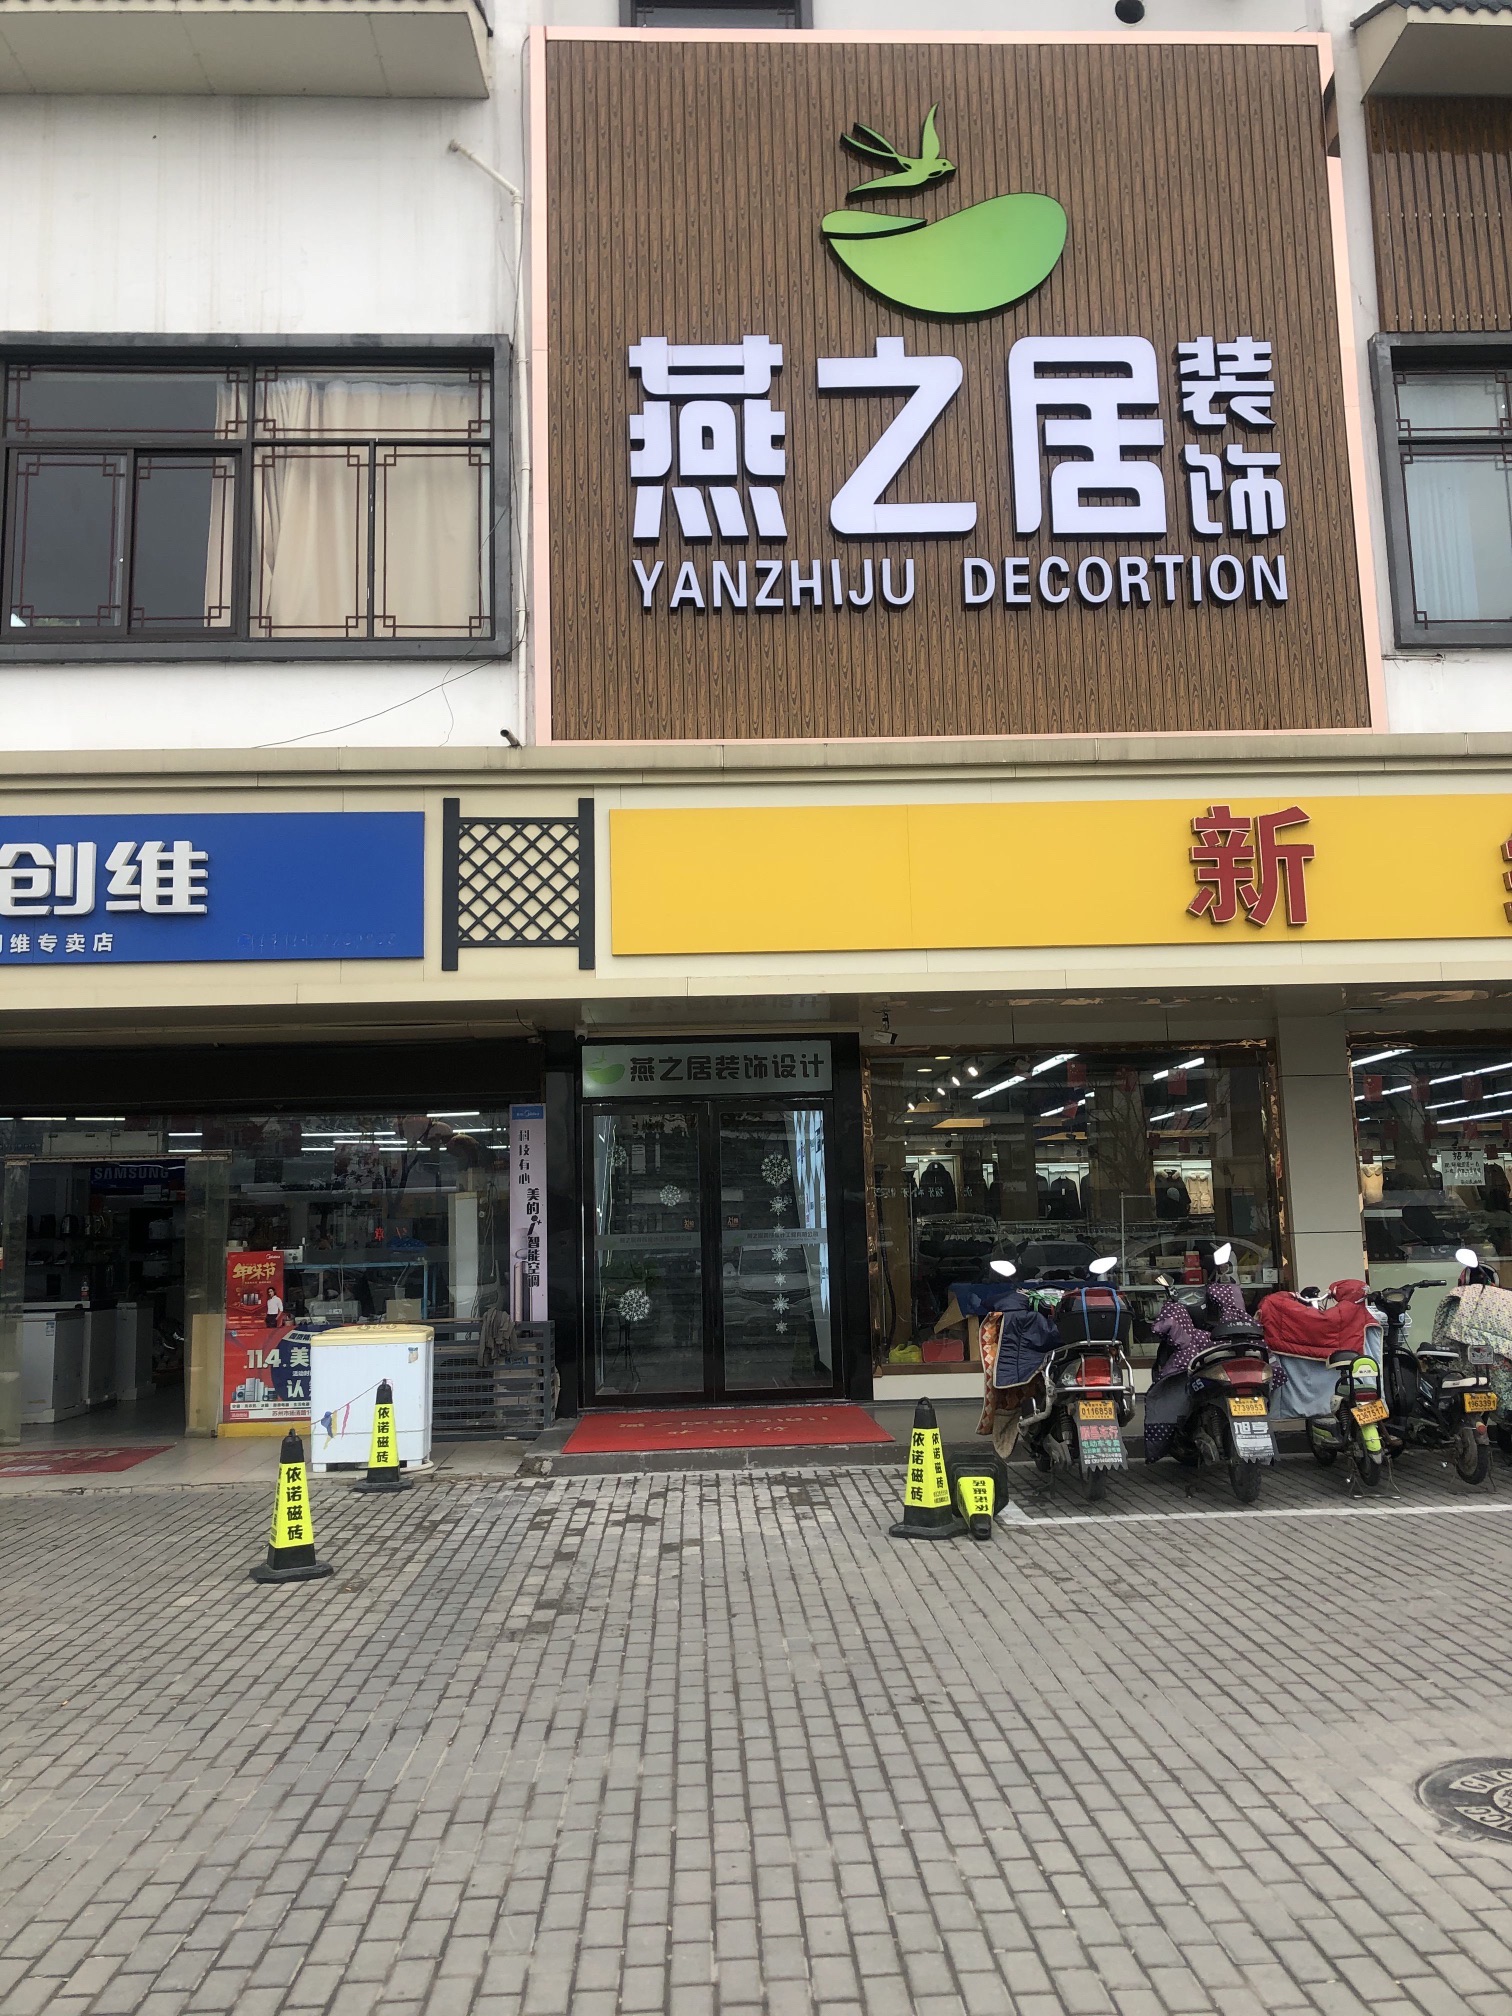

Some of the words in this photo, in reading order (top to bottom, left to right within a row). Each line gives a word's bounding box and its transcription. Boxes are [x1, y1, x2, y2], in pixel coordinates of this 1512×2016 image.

[628, 334, 1167, 541] 燕之居
[632, 559, 916, 609] YANZHIJU
[963, 554, 1289, 604] DECORTION
[0, 840, 209, 917] 创维
[1186, 804, 1316, 927] 新
[0, 932, 114, 954] 维专卖店
[629, 1052, 825, 1083] 燕之居装饰设计
[94, 1167, 169, 1180] SAMSUNG
[376, 1406, 390, 1464] 依诺磁砖
[932, 1433, 944, 1488] 依诺磁砖
[911, 1432, 925, 1502] 依诺磁砖
[286, 1467, 303, 1540] 依诺磁砖
